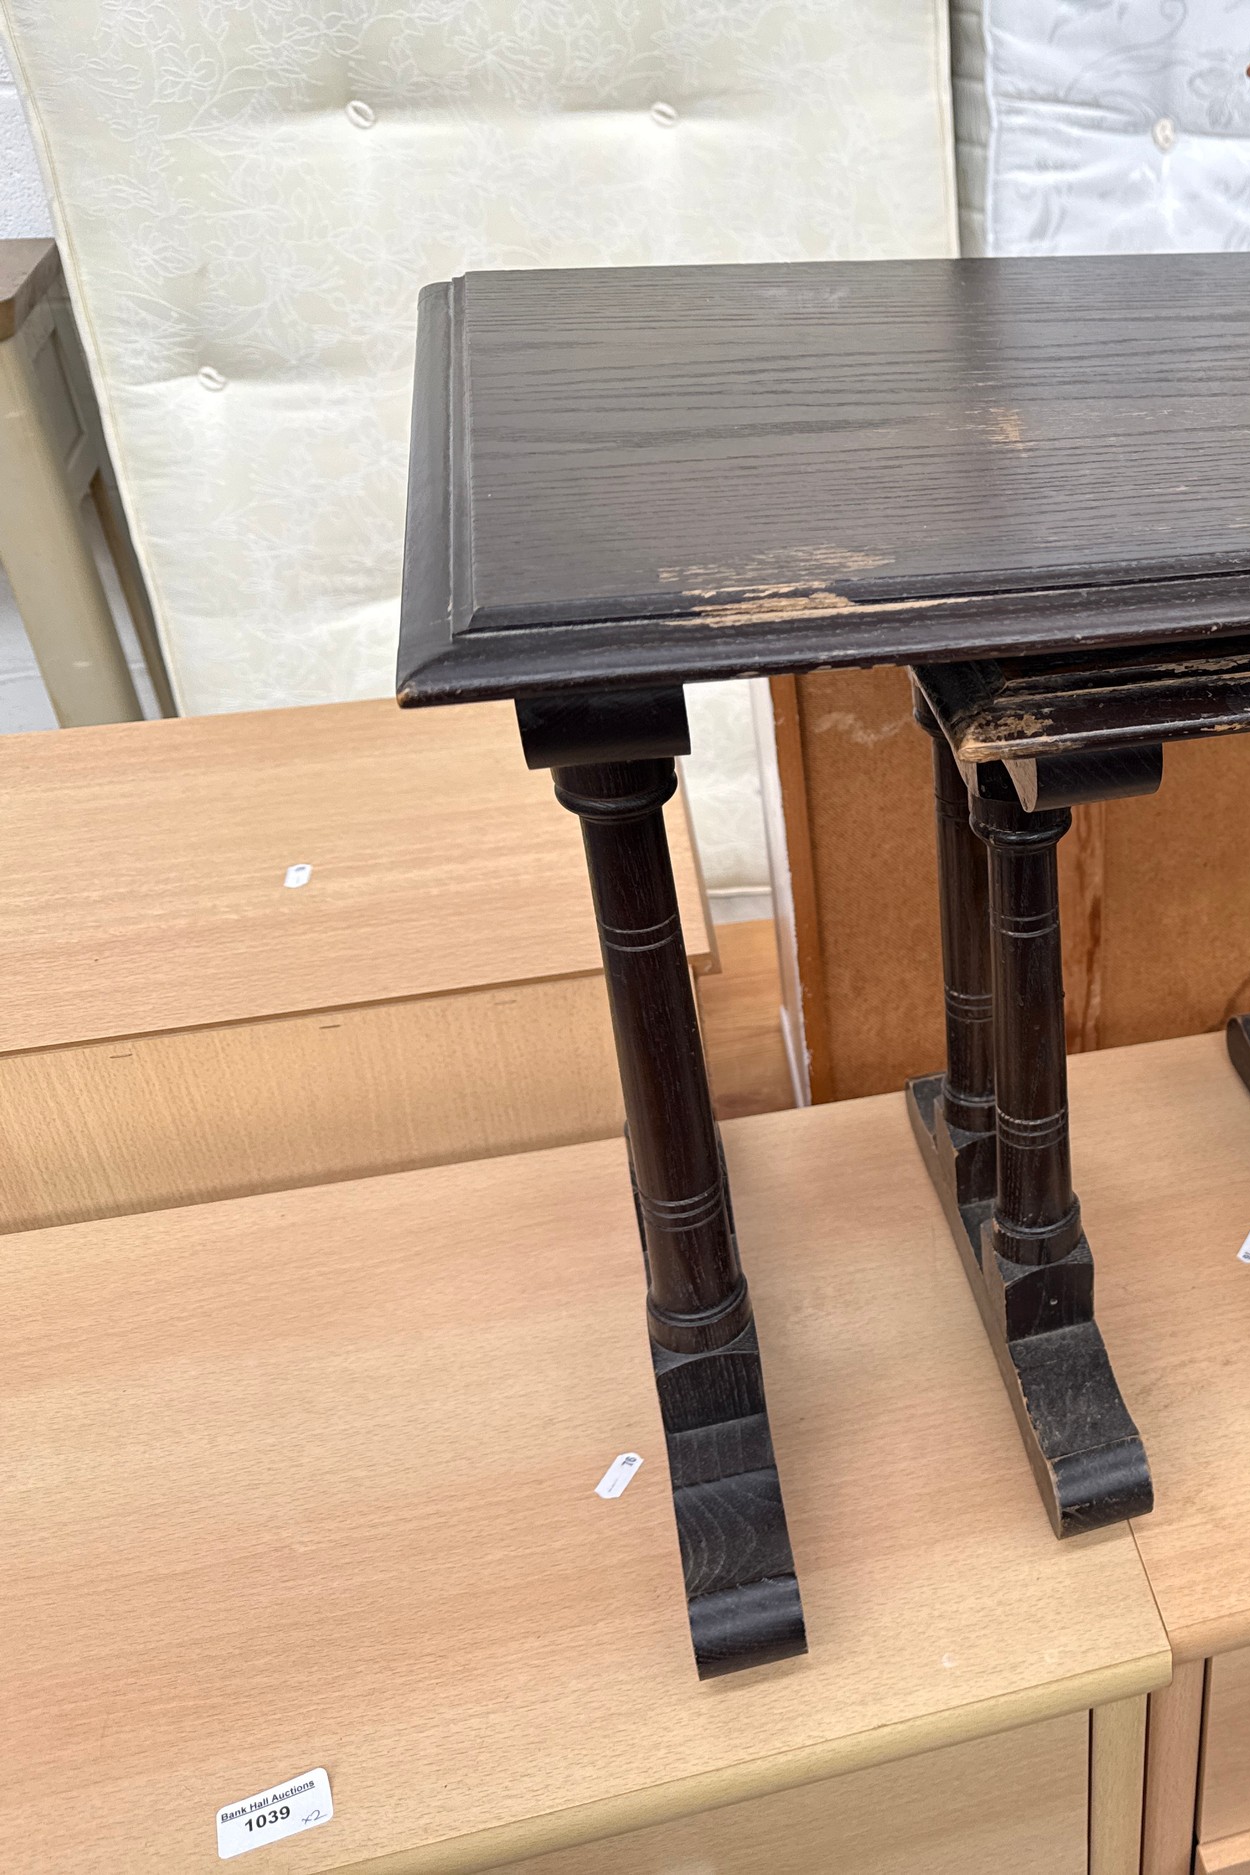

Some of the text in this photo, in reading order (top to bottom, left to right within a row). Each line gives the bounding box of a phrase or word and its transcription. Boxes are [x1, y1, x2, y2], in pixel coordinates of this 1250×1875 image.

[221, 1780, 315, 1822] Bank Hall Auctions
[244, 1805, 291, 1832] 1039
